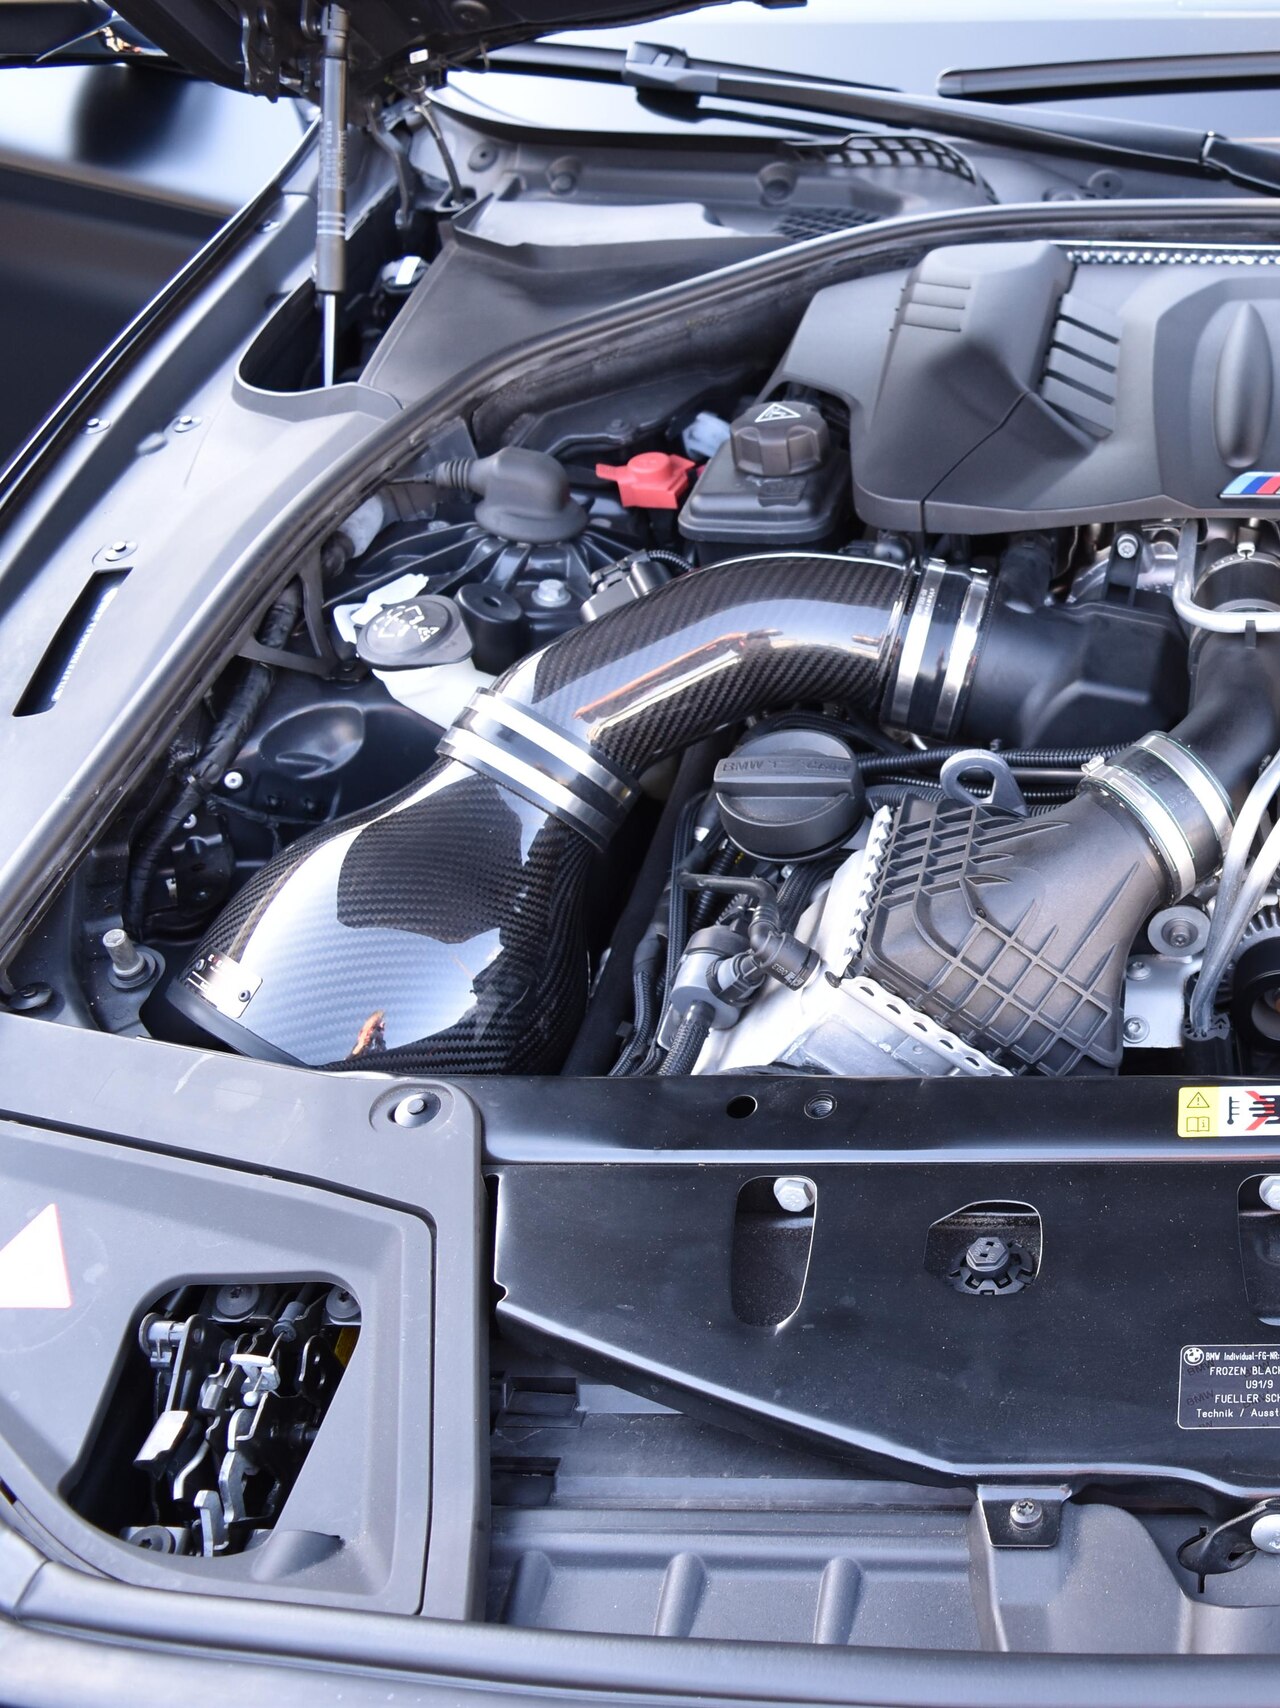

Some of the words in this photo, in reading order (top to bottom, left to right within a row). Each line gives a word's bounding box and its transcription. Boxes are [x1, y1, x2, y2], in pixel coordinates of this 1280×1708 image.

[1205, 1352, 1221, 1361] BMW
[1209, 1366, 1247, 1376] FROZEN
[1245, 1379, 1274, 1390] U91/9
[1214, 1393, 1260, 1404] FUELLER
[1196, 1408, 1234, 1418] Technik
